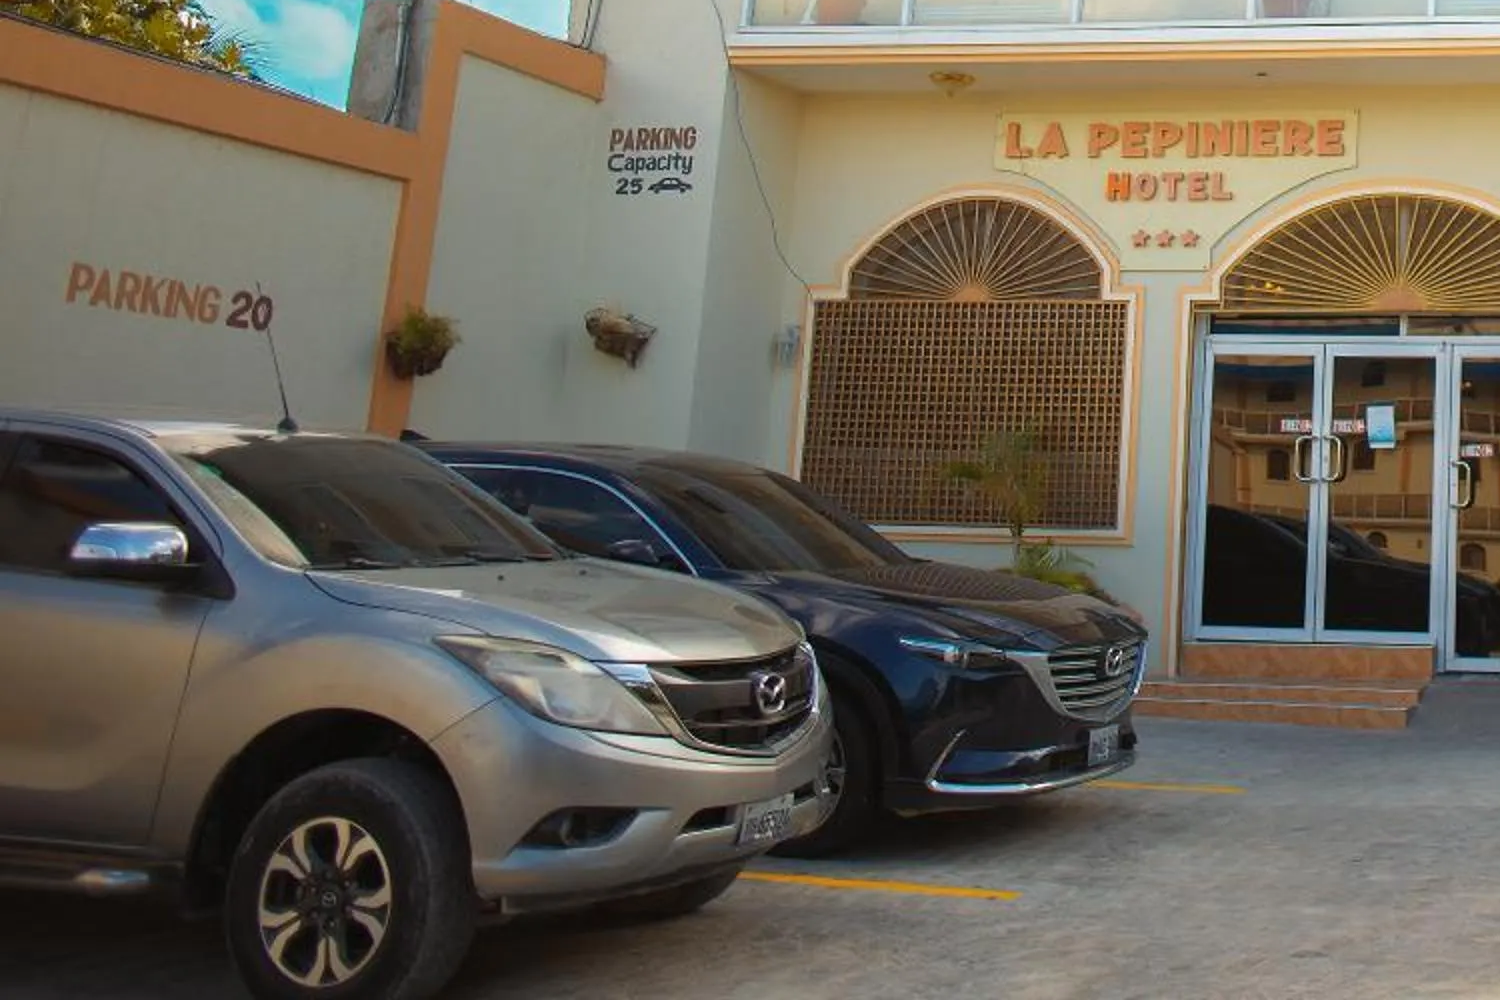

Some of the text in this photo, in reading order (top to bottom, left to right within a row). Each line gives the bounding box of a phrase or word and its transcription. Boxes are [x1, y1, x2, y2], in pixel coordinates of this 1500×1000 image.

[609, 126, 697, 152] PARKING
[1003, 118, 1346, 160] LA PEPINIERE
[607, 152, 694, 175] Capacity
[616, 178, 644, 195] 25
[1106, 171, 1234, 202] HOTEL
[65, 262, 273, 331] PARKING 20
